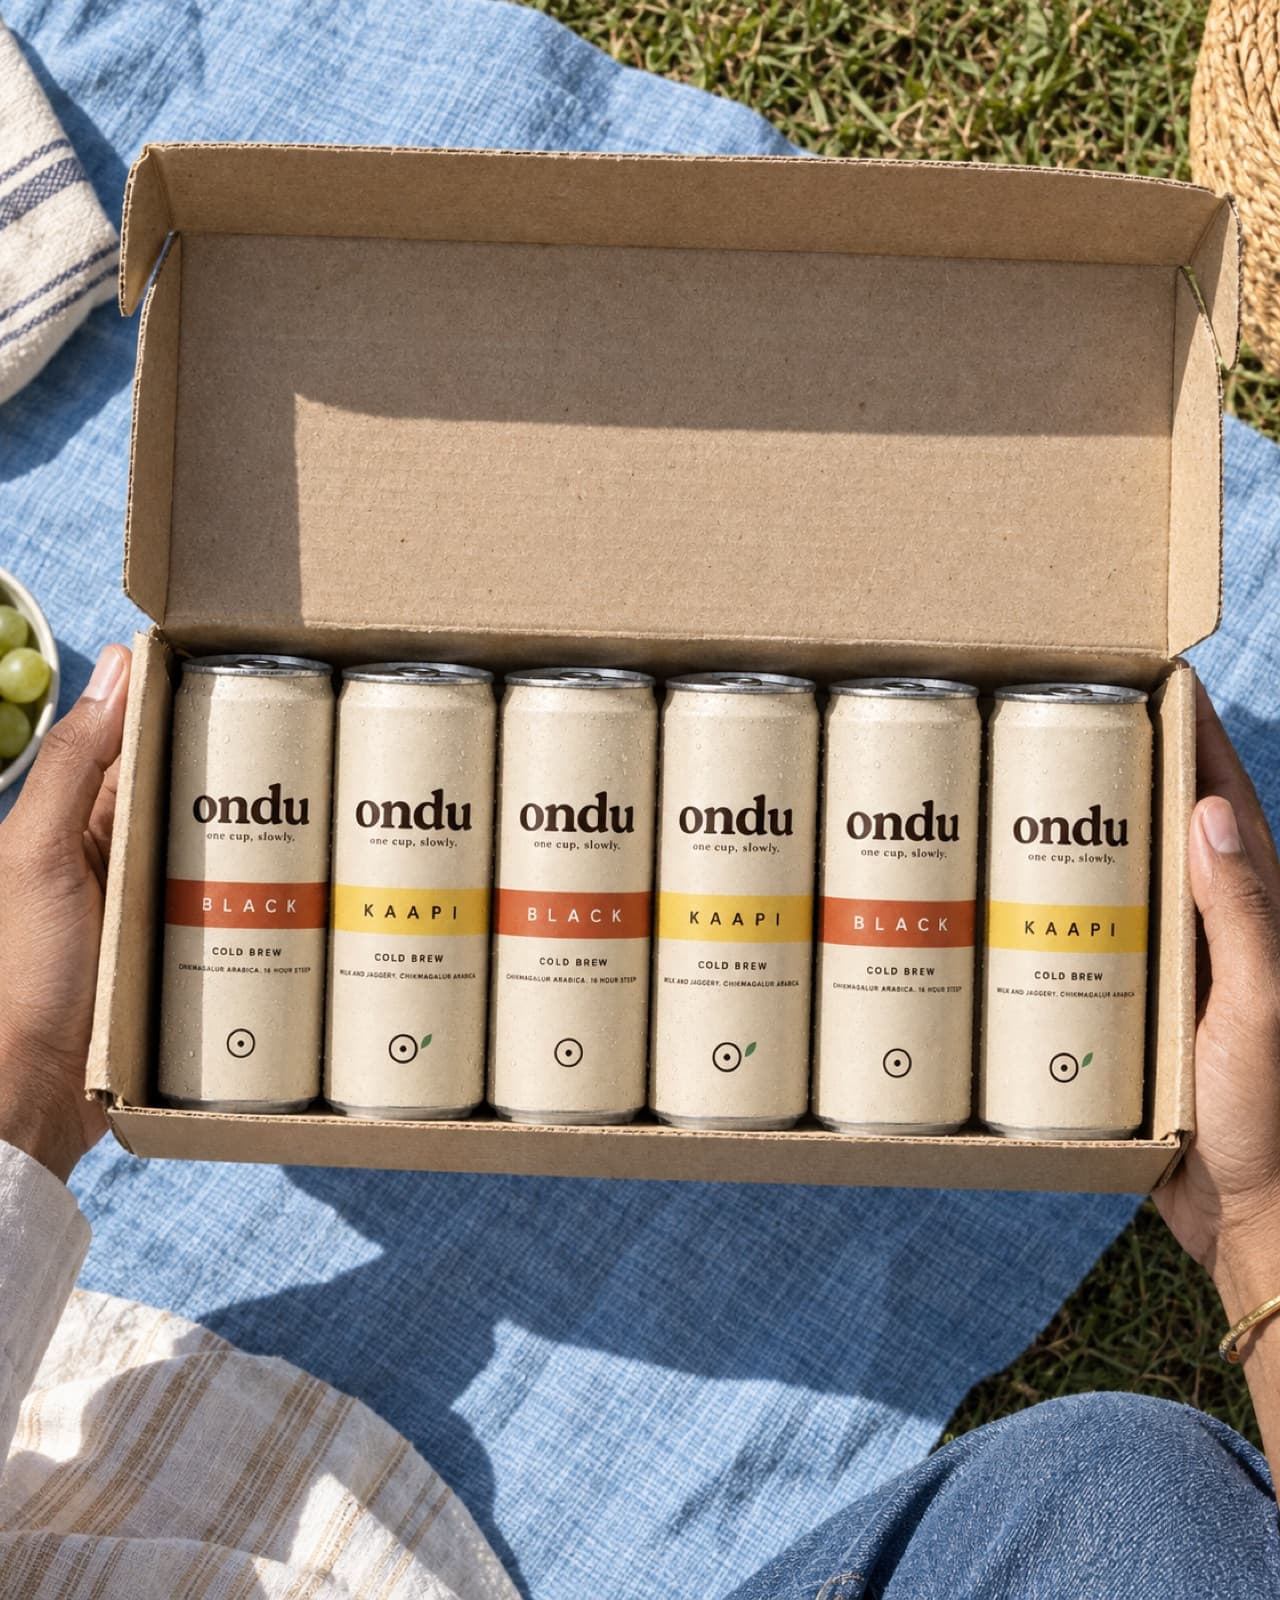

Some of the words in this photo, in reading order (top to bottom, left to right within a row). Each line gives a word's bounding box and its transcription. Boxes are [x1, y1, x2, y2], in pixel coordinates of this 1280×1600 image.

[193, 782, 310, 825] ondu
[355, 788, 472, 831] ondu
[519, 791, 635, 834] ondu
[679, 794, 794, 836] ondu
[846, 799, 960, 842] ondu
[1013, 804, 1129, 847] ondu
[206, 832, 226, 840] one
[229, 833, 254, 843] cup,
[258, 831, 296, 844] slowly.
[369, 837, 388, 846] one
[391, 838, 416, 848] cup,
[420, 836, 458, 848] slowly.
[533, 840, 552, 849] one
[556, 841, 580, 851] cup,
[583, 840, 622, 852] slowly.
[692, 843, 711, 851] one
[714, 844, 739, 855] cup,
[742, 843, 780, 855] slowly.
[860, 849, 880, 857] one
[883, 850, 908, 860] cup,
[911, 848, 948, 860] slowly.
[1027, 853, 1047, 861] one
[1050, 854, 1075, 864] cup,
[1078, 852, 1116, 865] slowly.
[202, 897, 297, 913] BLACK
[364, 903, 457, 920] KAAPI
[527, 907, 622, 923] BLACK
[689, 911, 780, 926] KAAPI
[853, 915, 949, 932] BLACK
[1024, 921, 1116, 937] KAAPI
[212, 947, 244, 956] COLD
[249, 947, 282, 957] BREW
[374, 952, 406, 962] COLD
[411, 954, 444, 963] BREW
[539, 957, 570, 966] COLD
[575, 958, 608, 967] BREW
[697, 960, 729, 970] COLD
[734, 961, 768, 971] BREW
[866, 966, 898, 975] COLD
[903, 967, 936, 976] BREW
[1034, 970, 1066, 980] COLD
[1071, 972, 1104, 981] BREW
